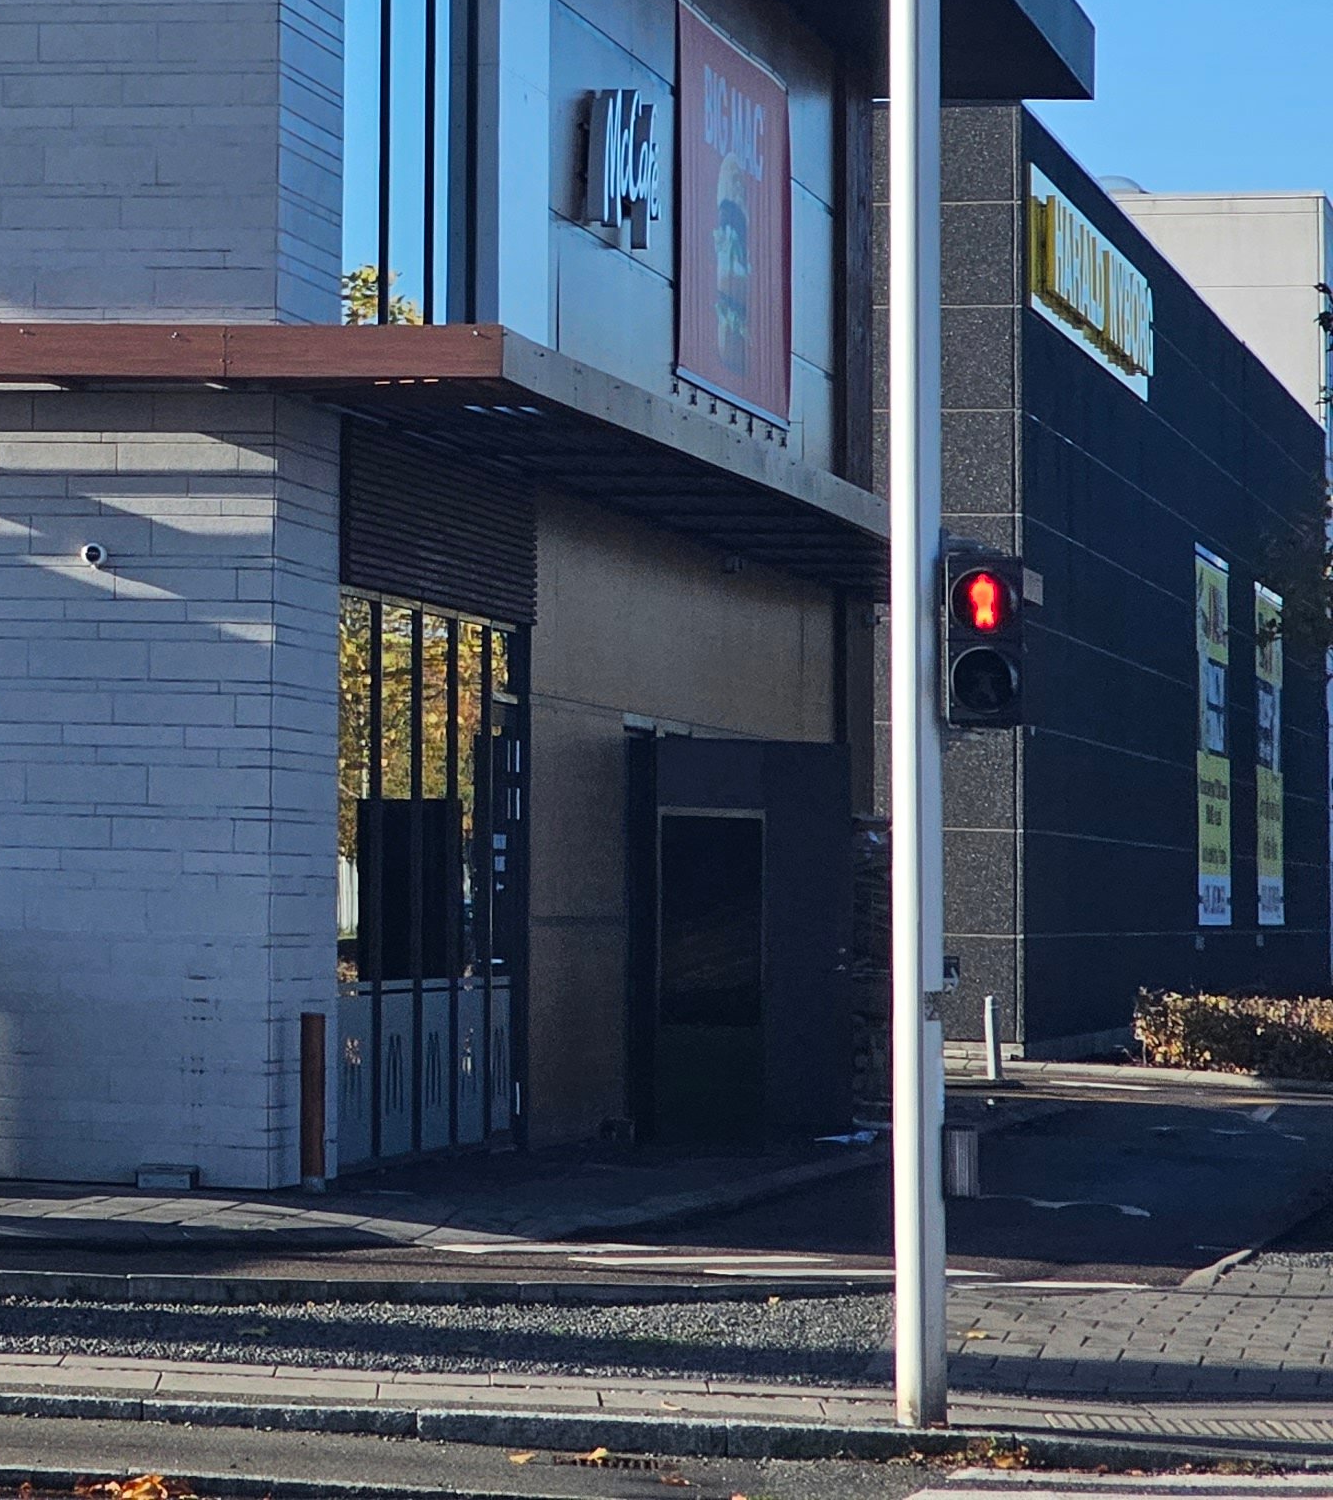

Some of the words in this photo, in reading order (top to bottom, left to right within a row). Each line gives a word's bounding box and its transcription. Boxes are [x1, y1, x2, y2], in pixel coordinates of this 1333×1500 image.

[703, 64, 729, 157] BIG
[731, 86, 765, 183] MAC
[1051, 195, 1105, 332] HARALD
[1108, 252, 1154, 377] NYBORG
